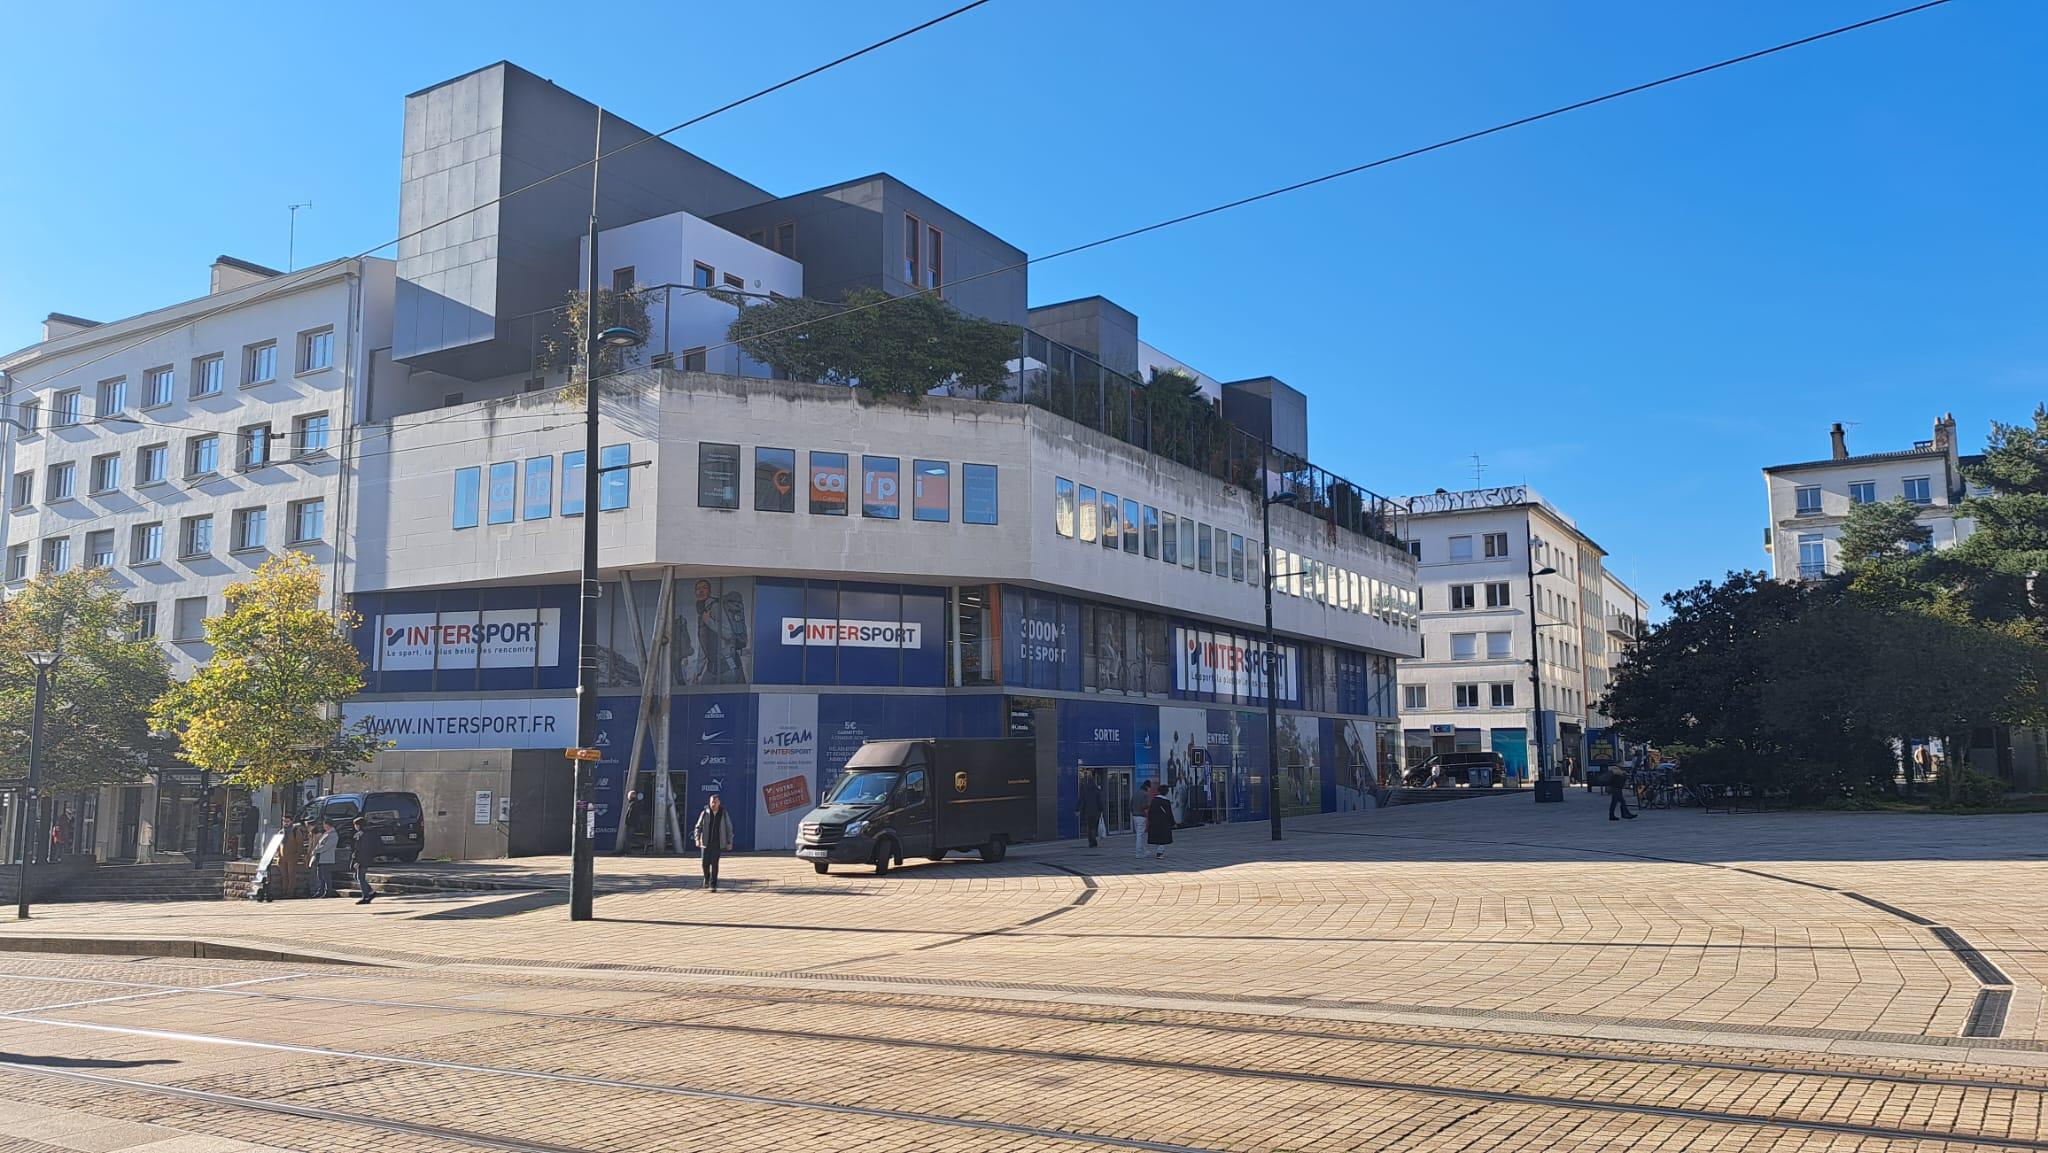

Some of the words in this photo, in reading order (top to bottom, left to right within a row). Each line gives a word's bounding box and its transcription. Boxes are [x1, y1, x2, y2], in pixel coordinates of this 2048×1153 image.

[814, 471, 924, 500] cafpi
[407, 622, 544, 646] INTERSPORT
[806, 624, 916, 643] INTERSPORT
[454, 647, 475, 655] belle
[1203, 641, 1285, 677] INTERSPOT
[365, 716, 556, 734] WWW.INTERSPORT.FR
[763, 736, 774, 745] LA
[775, 729, 812, 747] TEAM
[1094, 728, 1120, 741] SORTIE
